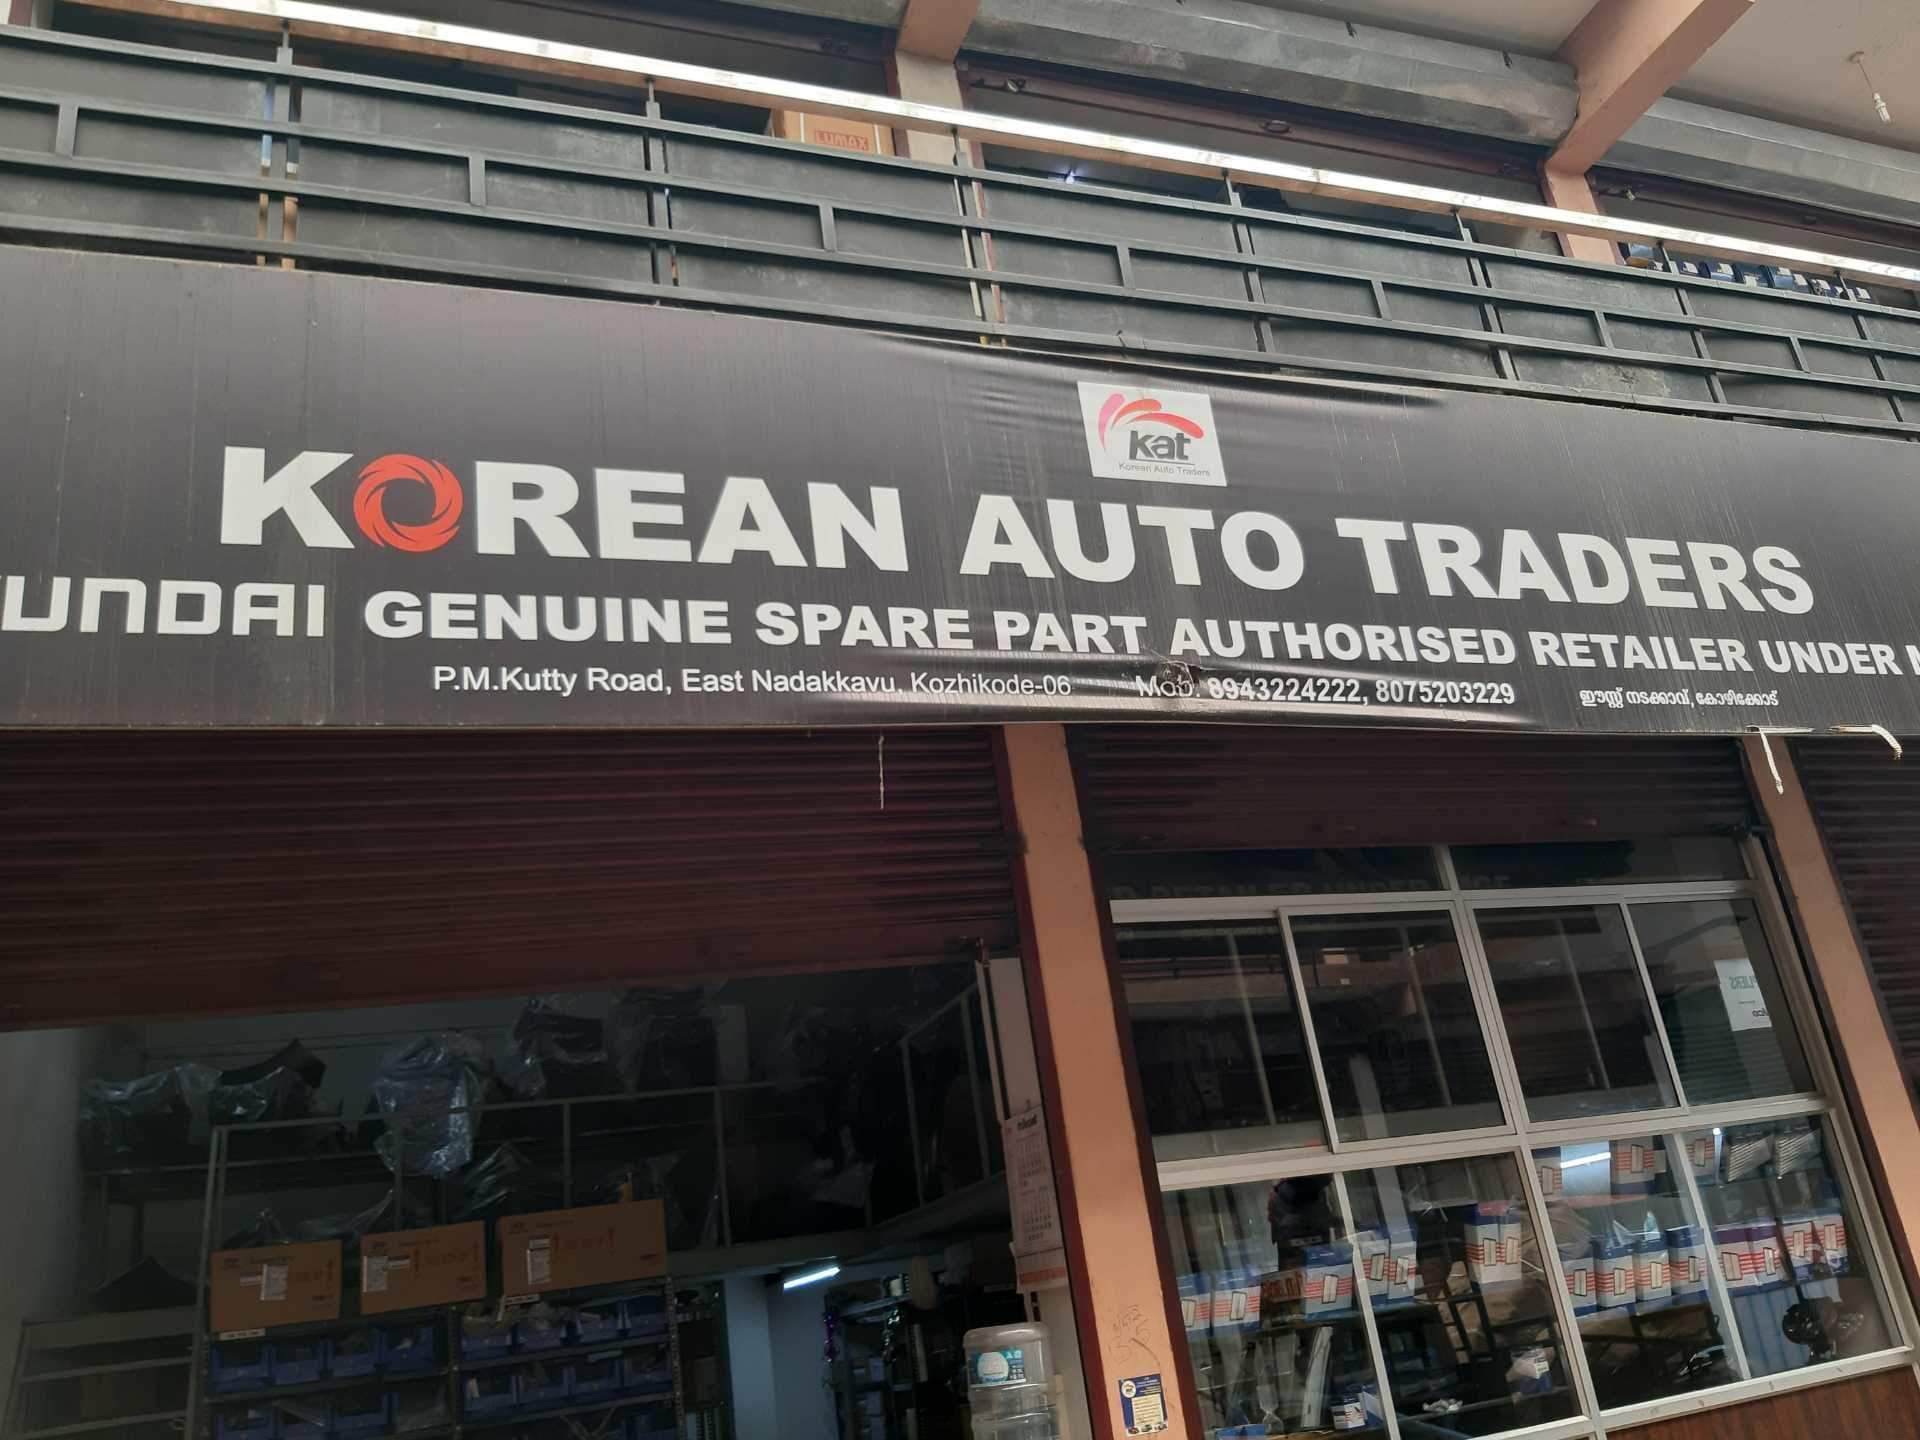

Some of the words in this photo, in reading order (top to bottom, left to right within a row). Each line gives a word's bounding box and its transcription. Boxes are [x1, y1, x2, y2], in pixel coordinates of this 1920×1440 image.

[816, 131, 868, 150] LUMAX
[1129, 431, 1190, 460] kat
[1118, 462, 1151, 473] Korean
[1154, 465, 1174, 474] Auto
[1177, 466, 1211, 476] Traders
[220, 445, 909, 572] KOREAN
[959, 494, 1305, 590] AUTO
[1335, 518, 1815, 614] TRADERS
[0, 575, 325, 637] UNDAI
[364, 590, 732, 643] GENUINE
[754, 602, 973, 650] SPARE
[994, 612, 1147, 654] PART
[1170, 619, 1516, 664] AUTHORISED
[1528, 631, 1754, 672] RETAILER
[1759, 640, 1904, 676] UNDER
[433, 666, 577, 697] P.M.Kutty
[587, 667, 672, 694] Road,
[682, 668, 745, 692] East
[911, 672, 1071, 695] Kozhikode-06
[1207, 677, 1368, 706] 8943224222,
[1376, 680, 1515, 705] 8075203229
[1695, 689, 1779, 706] കോഴിക്കോട്
